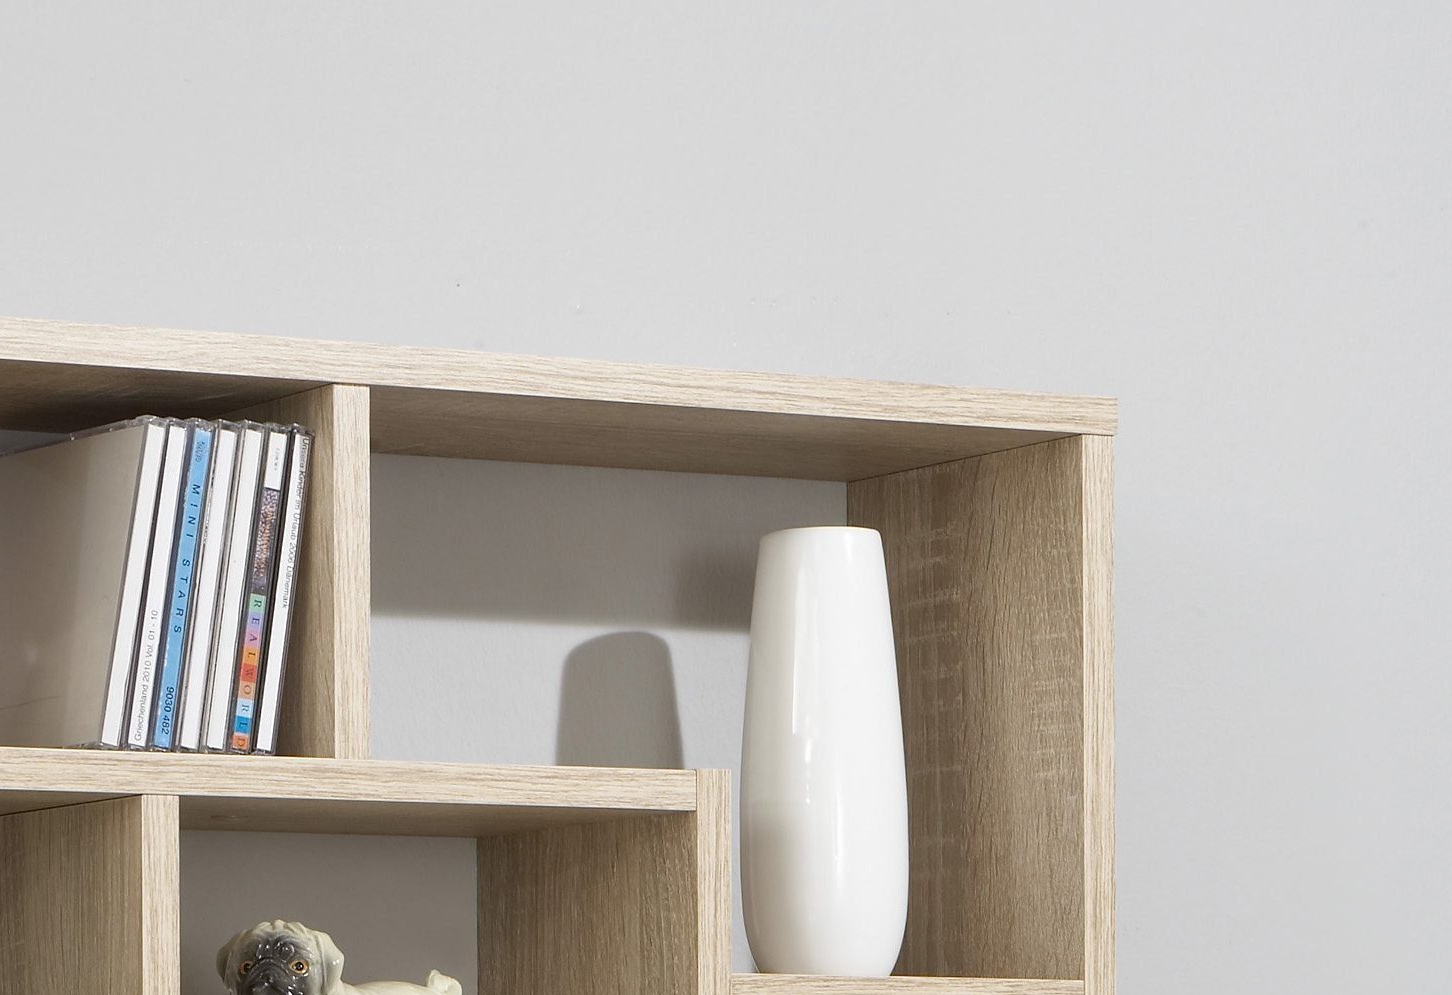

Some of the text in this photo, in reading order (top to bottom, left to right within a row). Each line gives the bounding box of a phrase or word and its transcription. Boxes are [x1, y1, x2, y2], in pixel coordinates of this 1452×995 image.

[296, 470, 305, 498] Kinder
[185, 483, 201, 539] MINI
[291, 512, 301, 540] Urlaub
[173, 558, 191, 634] STARS
[151, 609, 159, 620] 10
[148, 629, 156, 641] 01
[142, 661, 152, 683] 2010
[134, 684, 149, 742] Griechenland
[161, 686, 175, 735] 9030 482
